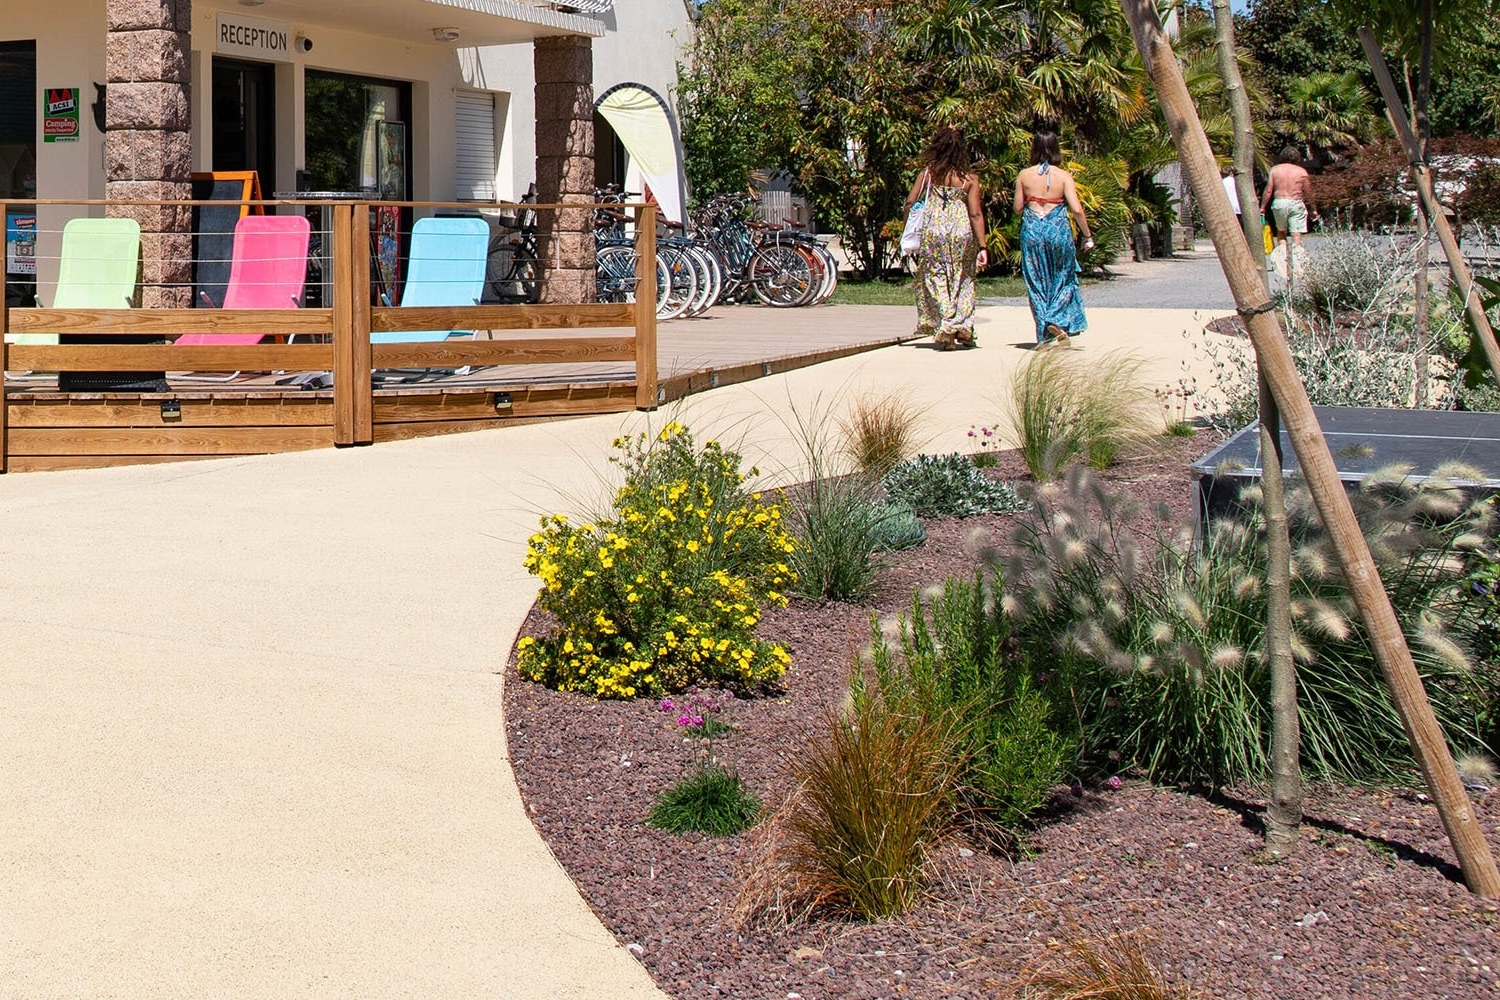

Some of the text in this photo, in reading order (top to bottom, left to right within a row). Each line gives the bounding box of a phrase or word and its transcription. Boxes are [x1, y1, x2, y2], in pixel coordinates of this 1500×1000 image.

[221, 23, 287, 51] RECEPTION
[52, 101, 70, 110] ACSI
[45, 118, 76, 129] Camping
